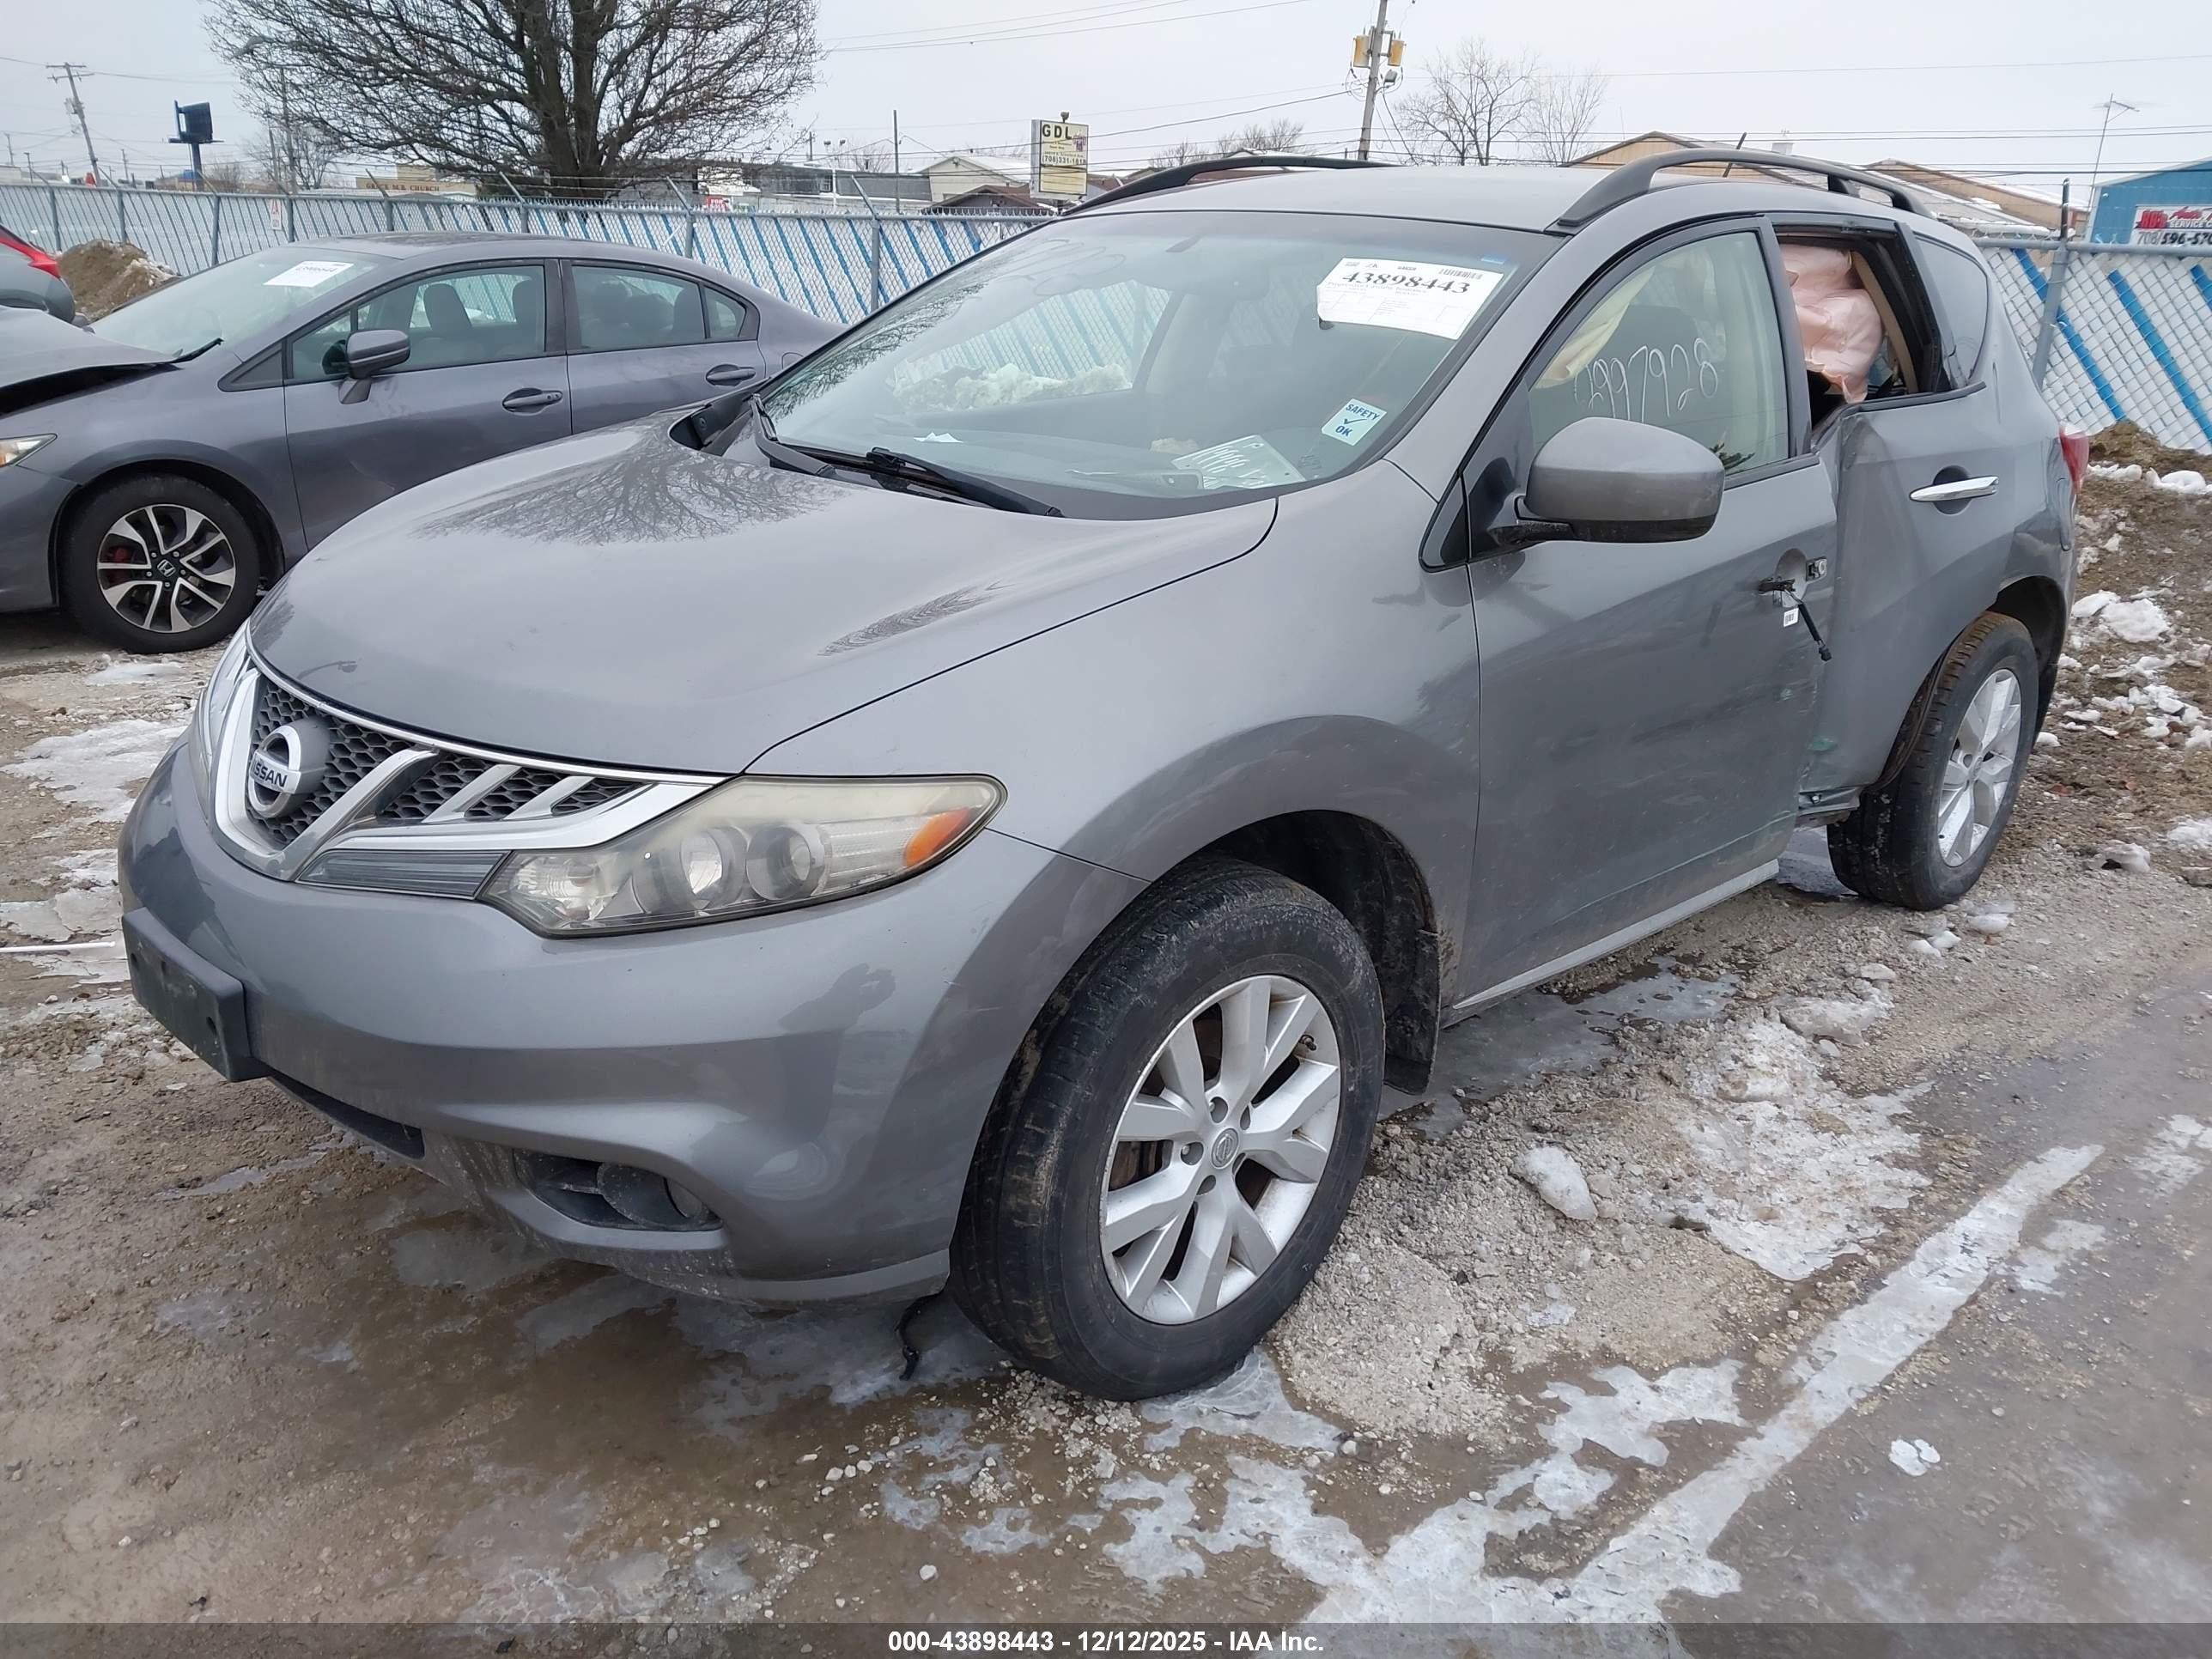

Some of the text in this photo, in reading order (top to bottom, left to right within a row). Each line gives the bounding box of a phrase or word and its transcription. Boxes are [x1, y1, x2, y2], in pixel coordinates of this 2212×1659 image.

[1042, 124, 1072, 140] GDL
[2170, 219, 2203, 228] SERVICE
[1342, 271, 1471, 294] 43898443
[1346, 404, 1380, 421] SAFETY
[1335, 425, 1353, 437] OK
